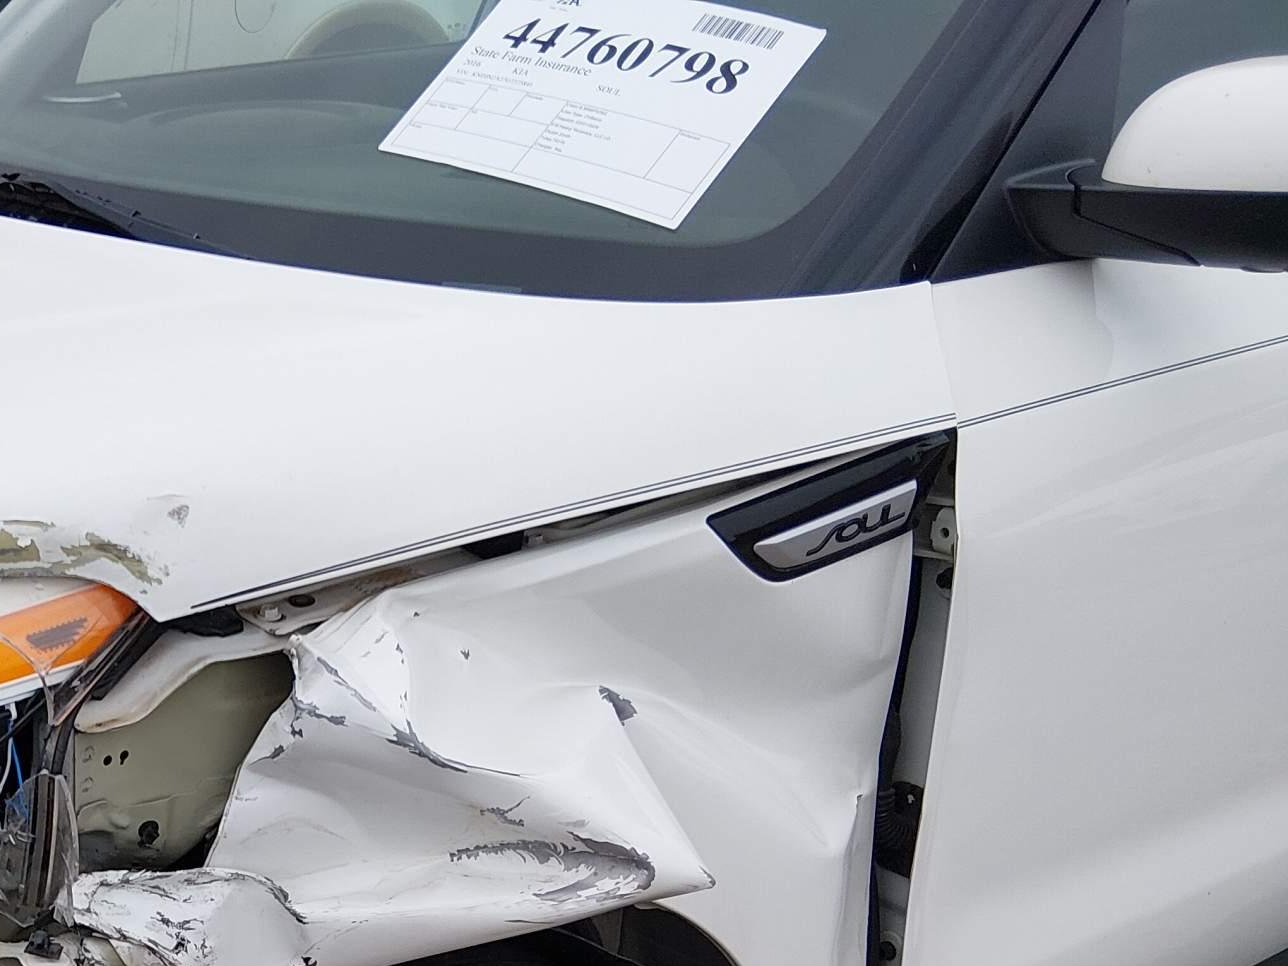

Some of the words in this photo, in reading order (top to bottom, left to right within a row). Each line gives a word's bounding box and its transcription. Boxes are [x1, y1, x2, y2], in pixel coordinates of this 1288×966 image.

[473, 46, 500, 59] State
[502, 50, 532, 64] Farm
[534, 57, 592, 76] Insurance
[502, 18, 750, 95] 44760798
[597, 83, 621, 96] SOUL
[806, 503, 906, 557] SOUL
